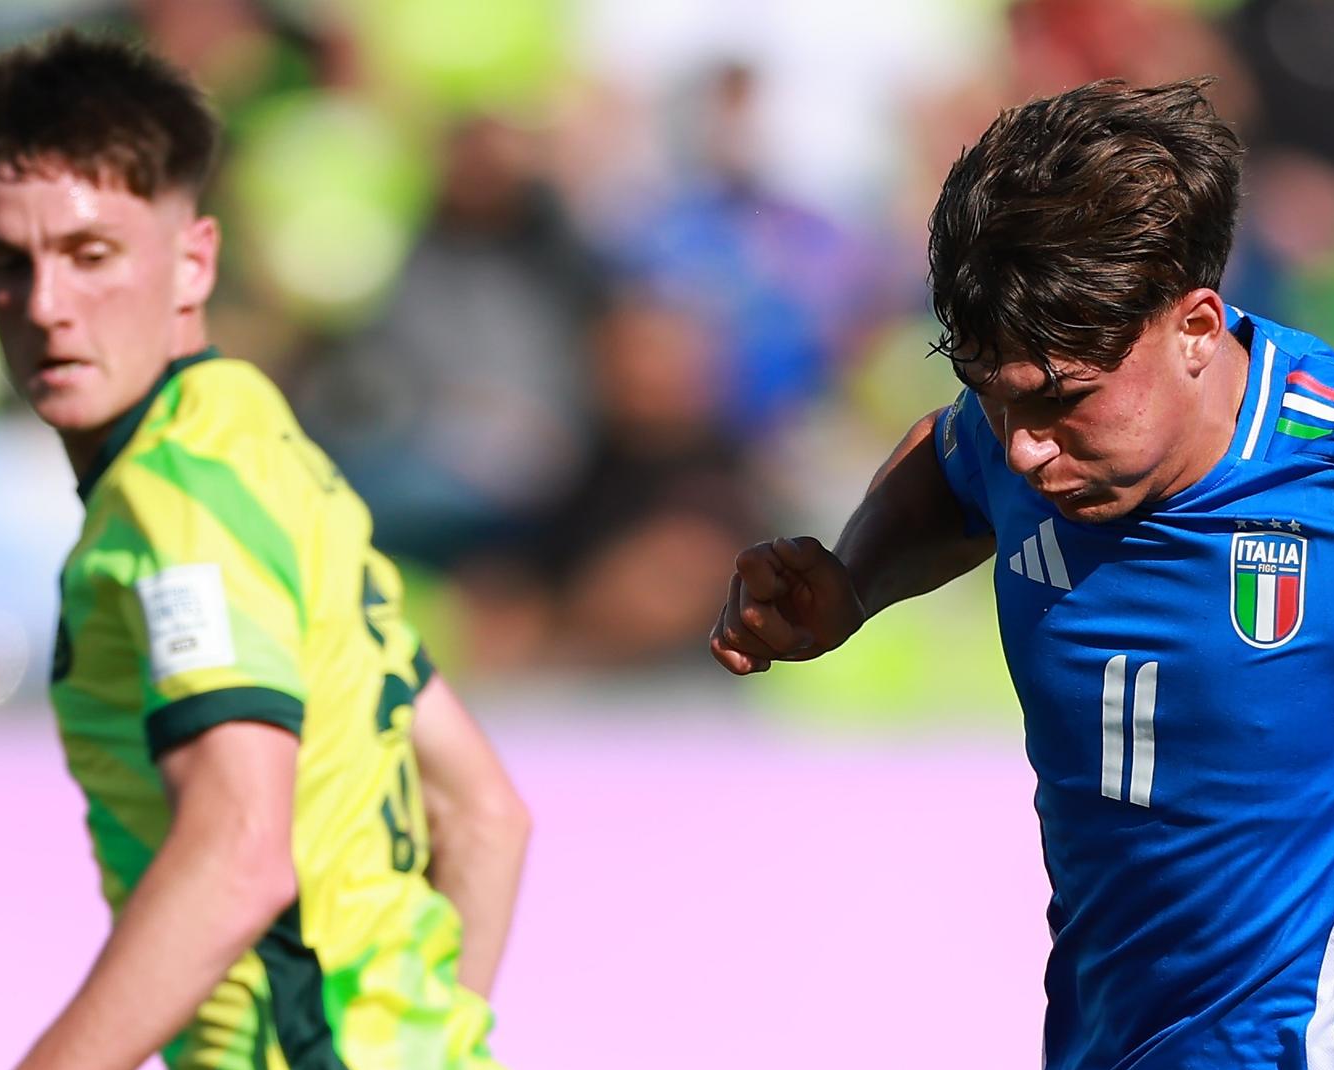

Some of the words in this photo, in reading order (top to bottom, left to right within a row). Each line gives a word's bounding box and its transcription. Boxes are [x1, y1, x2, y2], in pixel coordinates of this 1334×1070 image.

[1237, 540, 1300, 565] ITALIA
[1258, 564, 1277, 573] FIGC
[1101, 654, 1159, 808] 11
